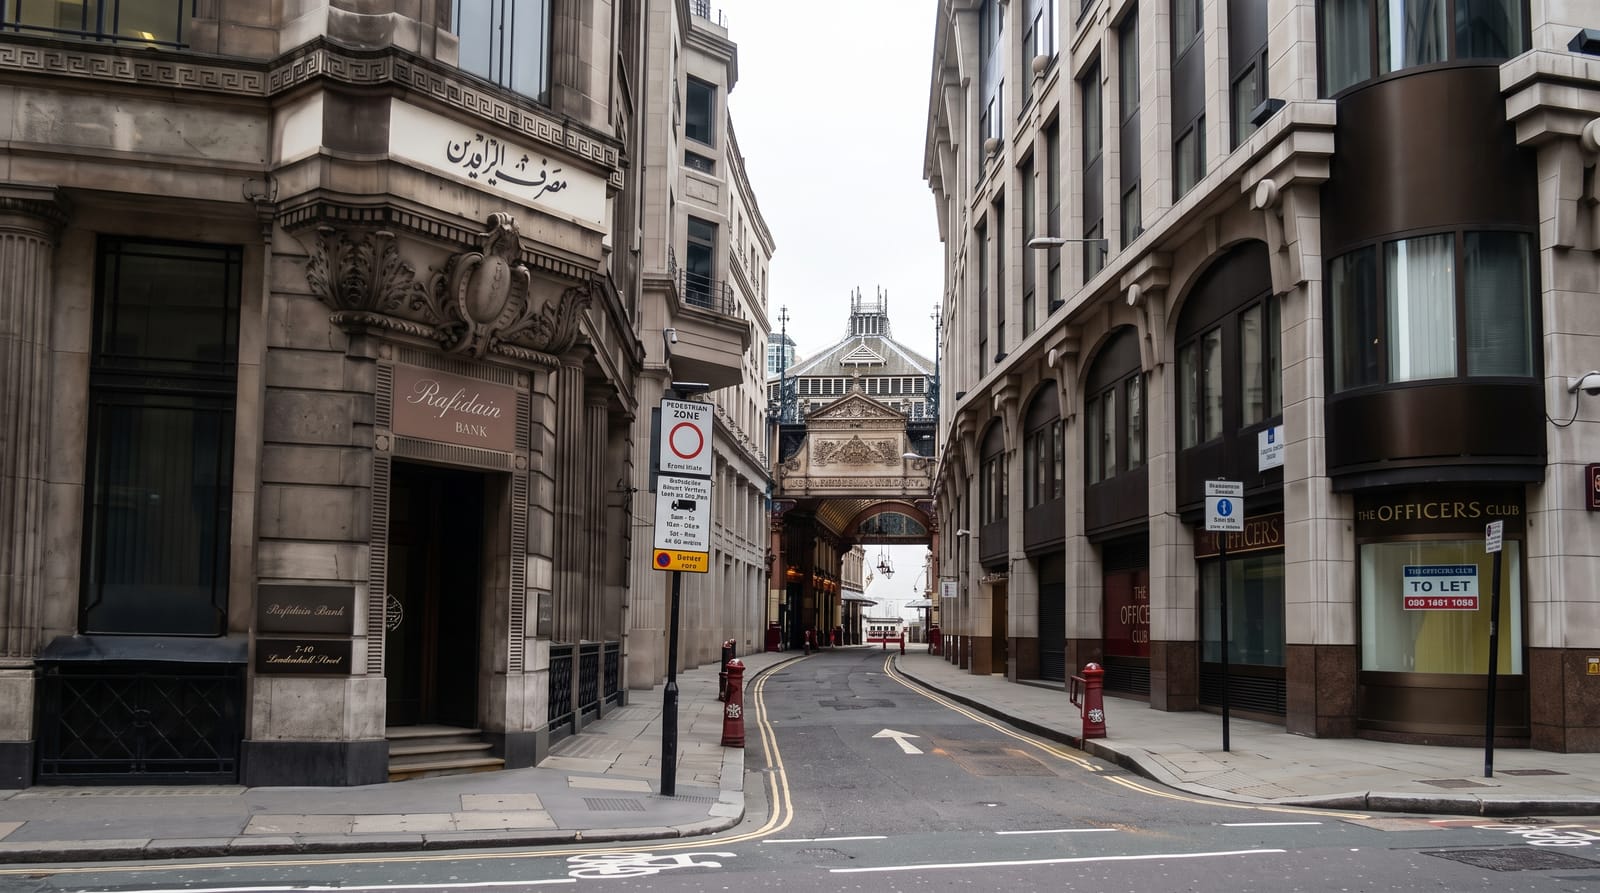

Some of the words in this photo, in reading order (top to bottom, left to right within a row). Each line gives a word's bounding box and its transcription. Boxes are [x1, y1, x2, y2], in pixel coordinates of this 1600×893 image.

[407, 378, 501, 418] Rafidain
[667, 402, 707, 412] PEDESTRIAN
[674, 410, 700, 420] ZONE
[455, 421, 488, 438] BANK
[1358, 510, 1376, 520] THE
[1378, 501, 1481, 521] OFFICERS
[1486, 504, 1519, 516] CLUB
[1134, 586, 1147, 599] THE
[1410, 581, 1432, 592] TO
[1440, 581, 1470, 592] LET
[314, 605, 344, 616] Bank
[1132, 629, 1148, 643] CLUB
